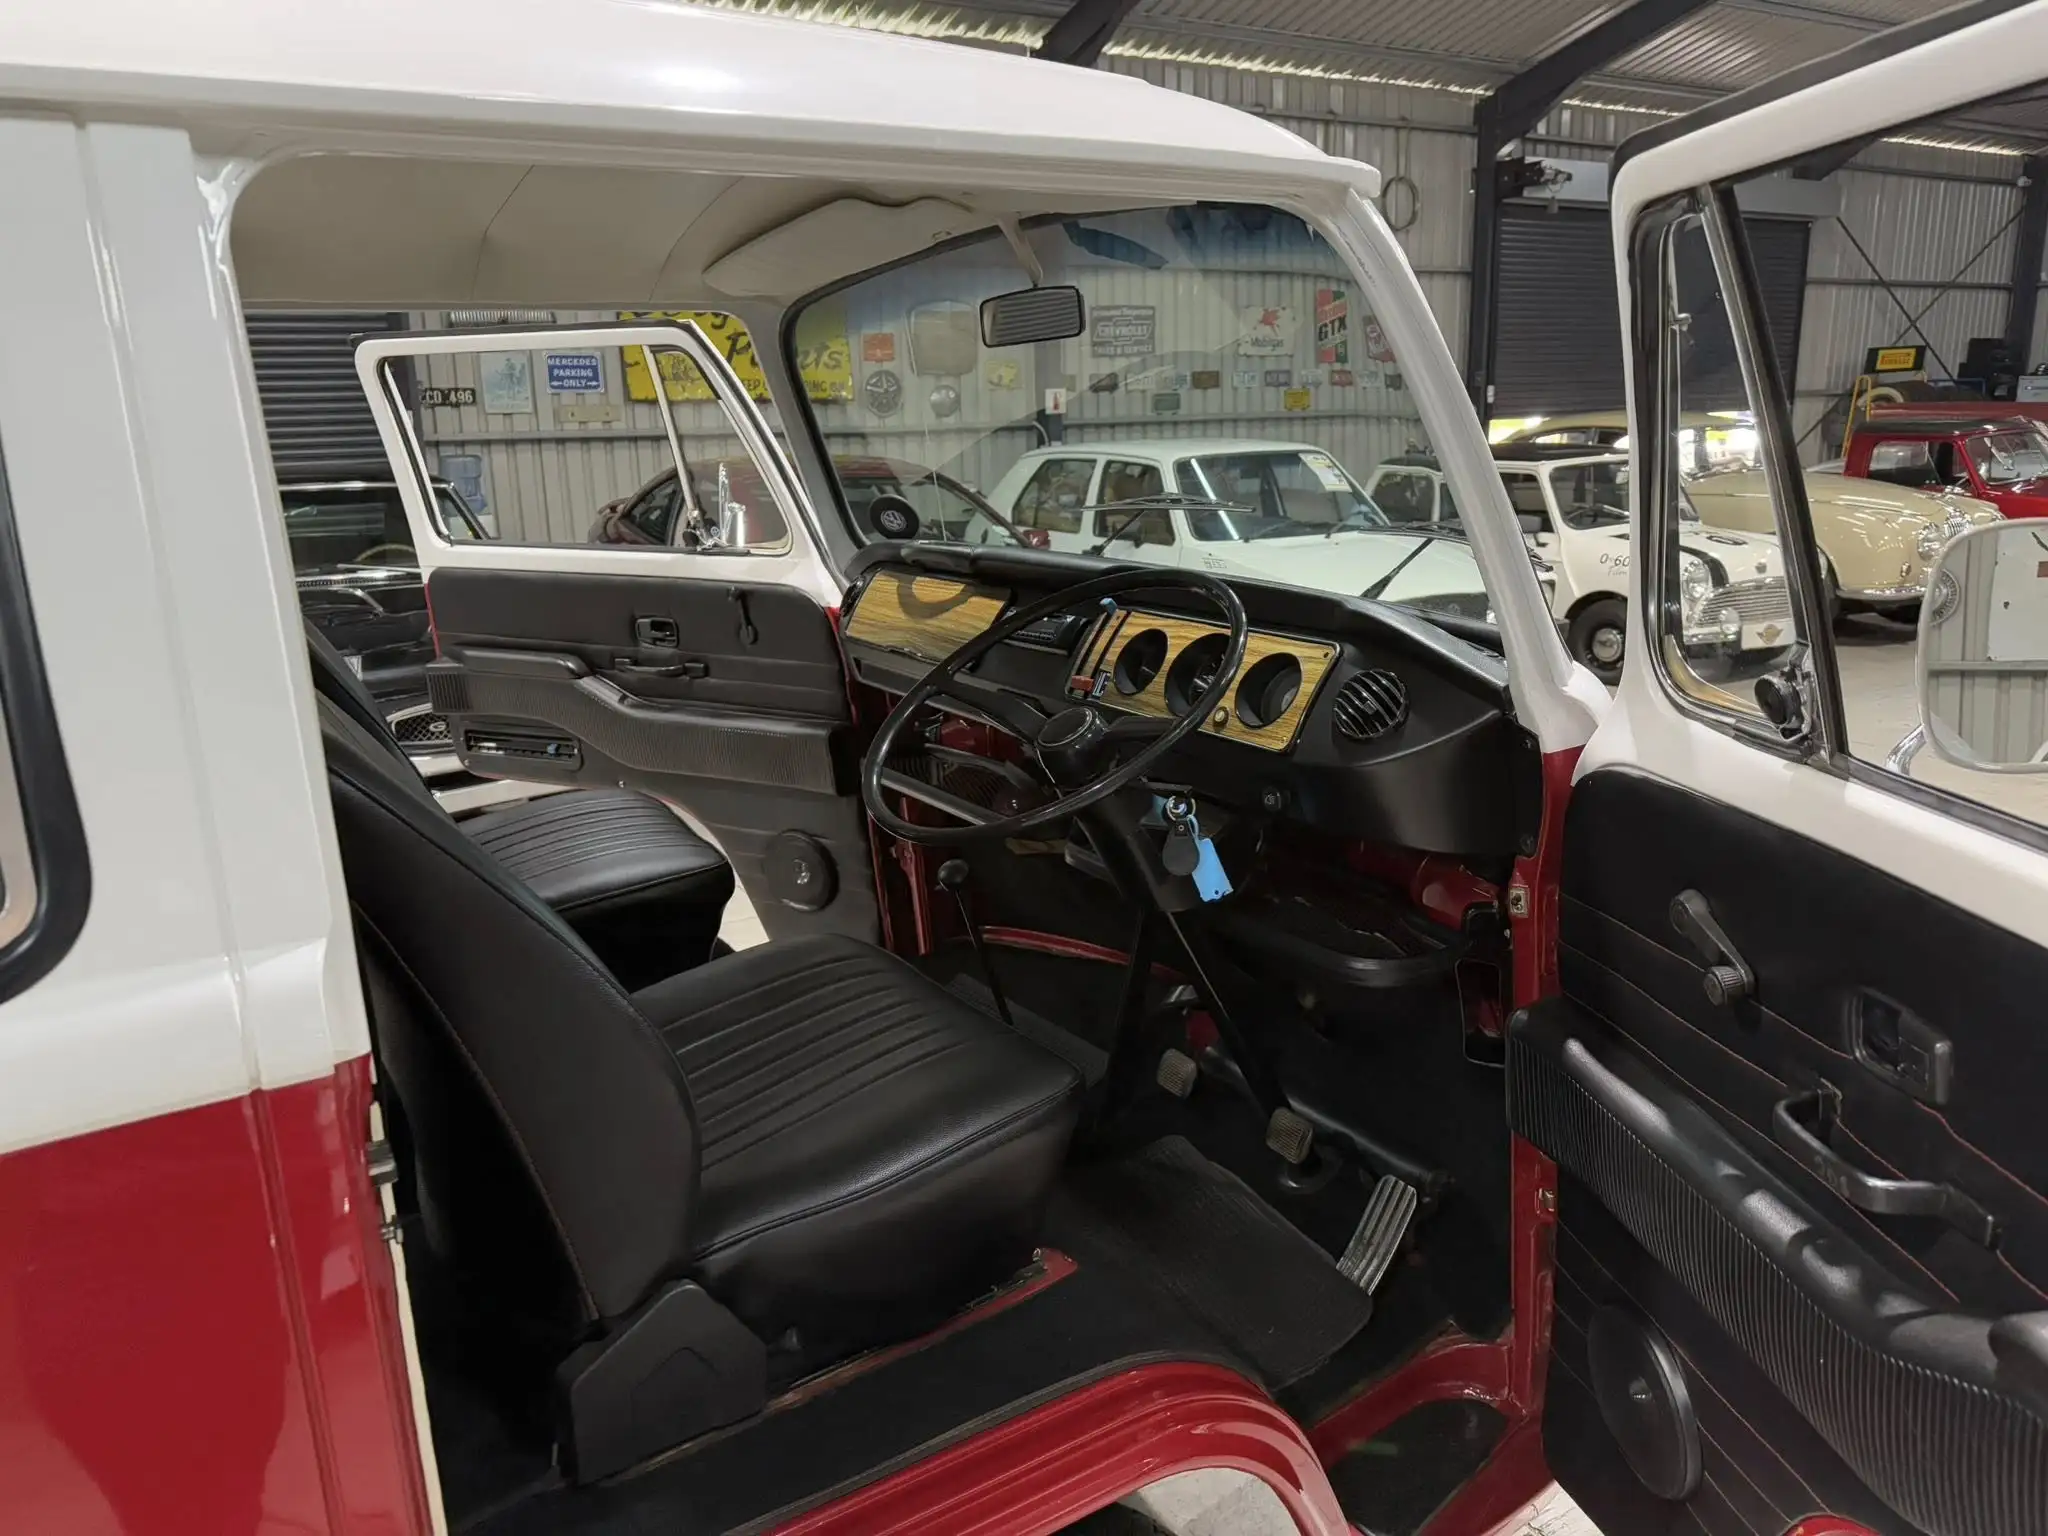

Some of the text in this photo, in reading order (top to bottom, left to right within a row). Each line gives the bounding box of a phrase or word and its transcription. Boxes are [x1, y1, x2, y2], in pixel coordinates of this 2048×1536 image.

[1318, 314, 1347, 341] GTX
[547, 357, 597, 366] MERCEDES
[552, 368, 593, 377] PARKING
[563, 379, 587, 388] ONLY
[449, 390, 474, 404] 496
